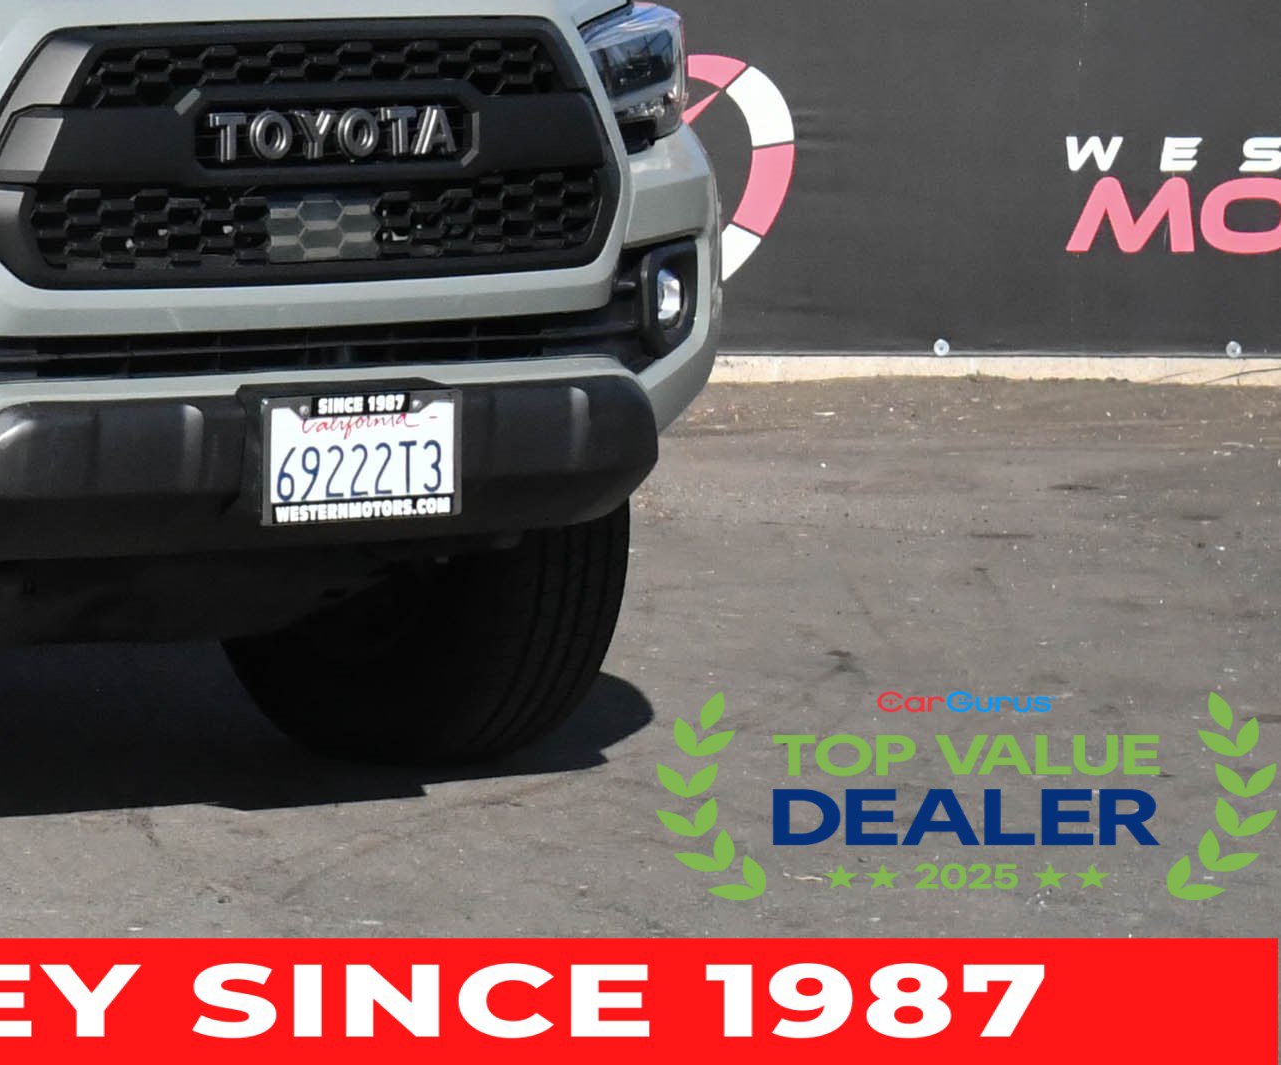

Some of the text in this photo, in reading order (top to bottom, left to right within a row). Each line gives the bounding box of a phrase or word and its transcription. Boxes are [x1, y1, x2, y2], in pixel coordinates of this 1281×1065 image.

[209, 104, 457, 163] TOYOTA
[1065, 135, 1281, 172] WES
[317, 394, 406, 415] SINCE 1987
[276, 439, 442, 502] 69222T3
[275, 496, 452, 524] WESTERNMOTORS.COM
